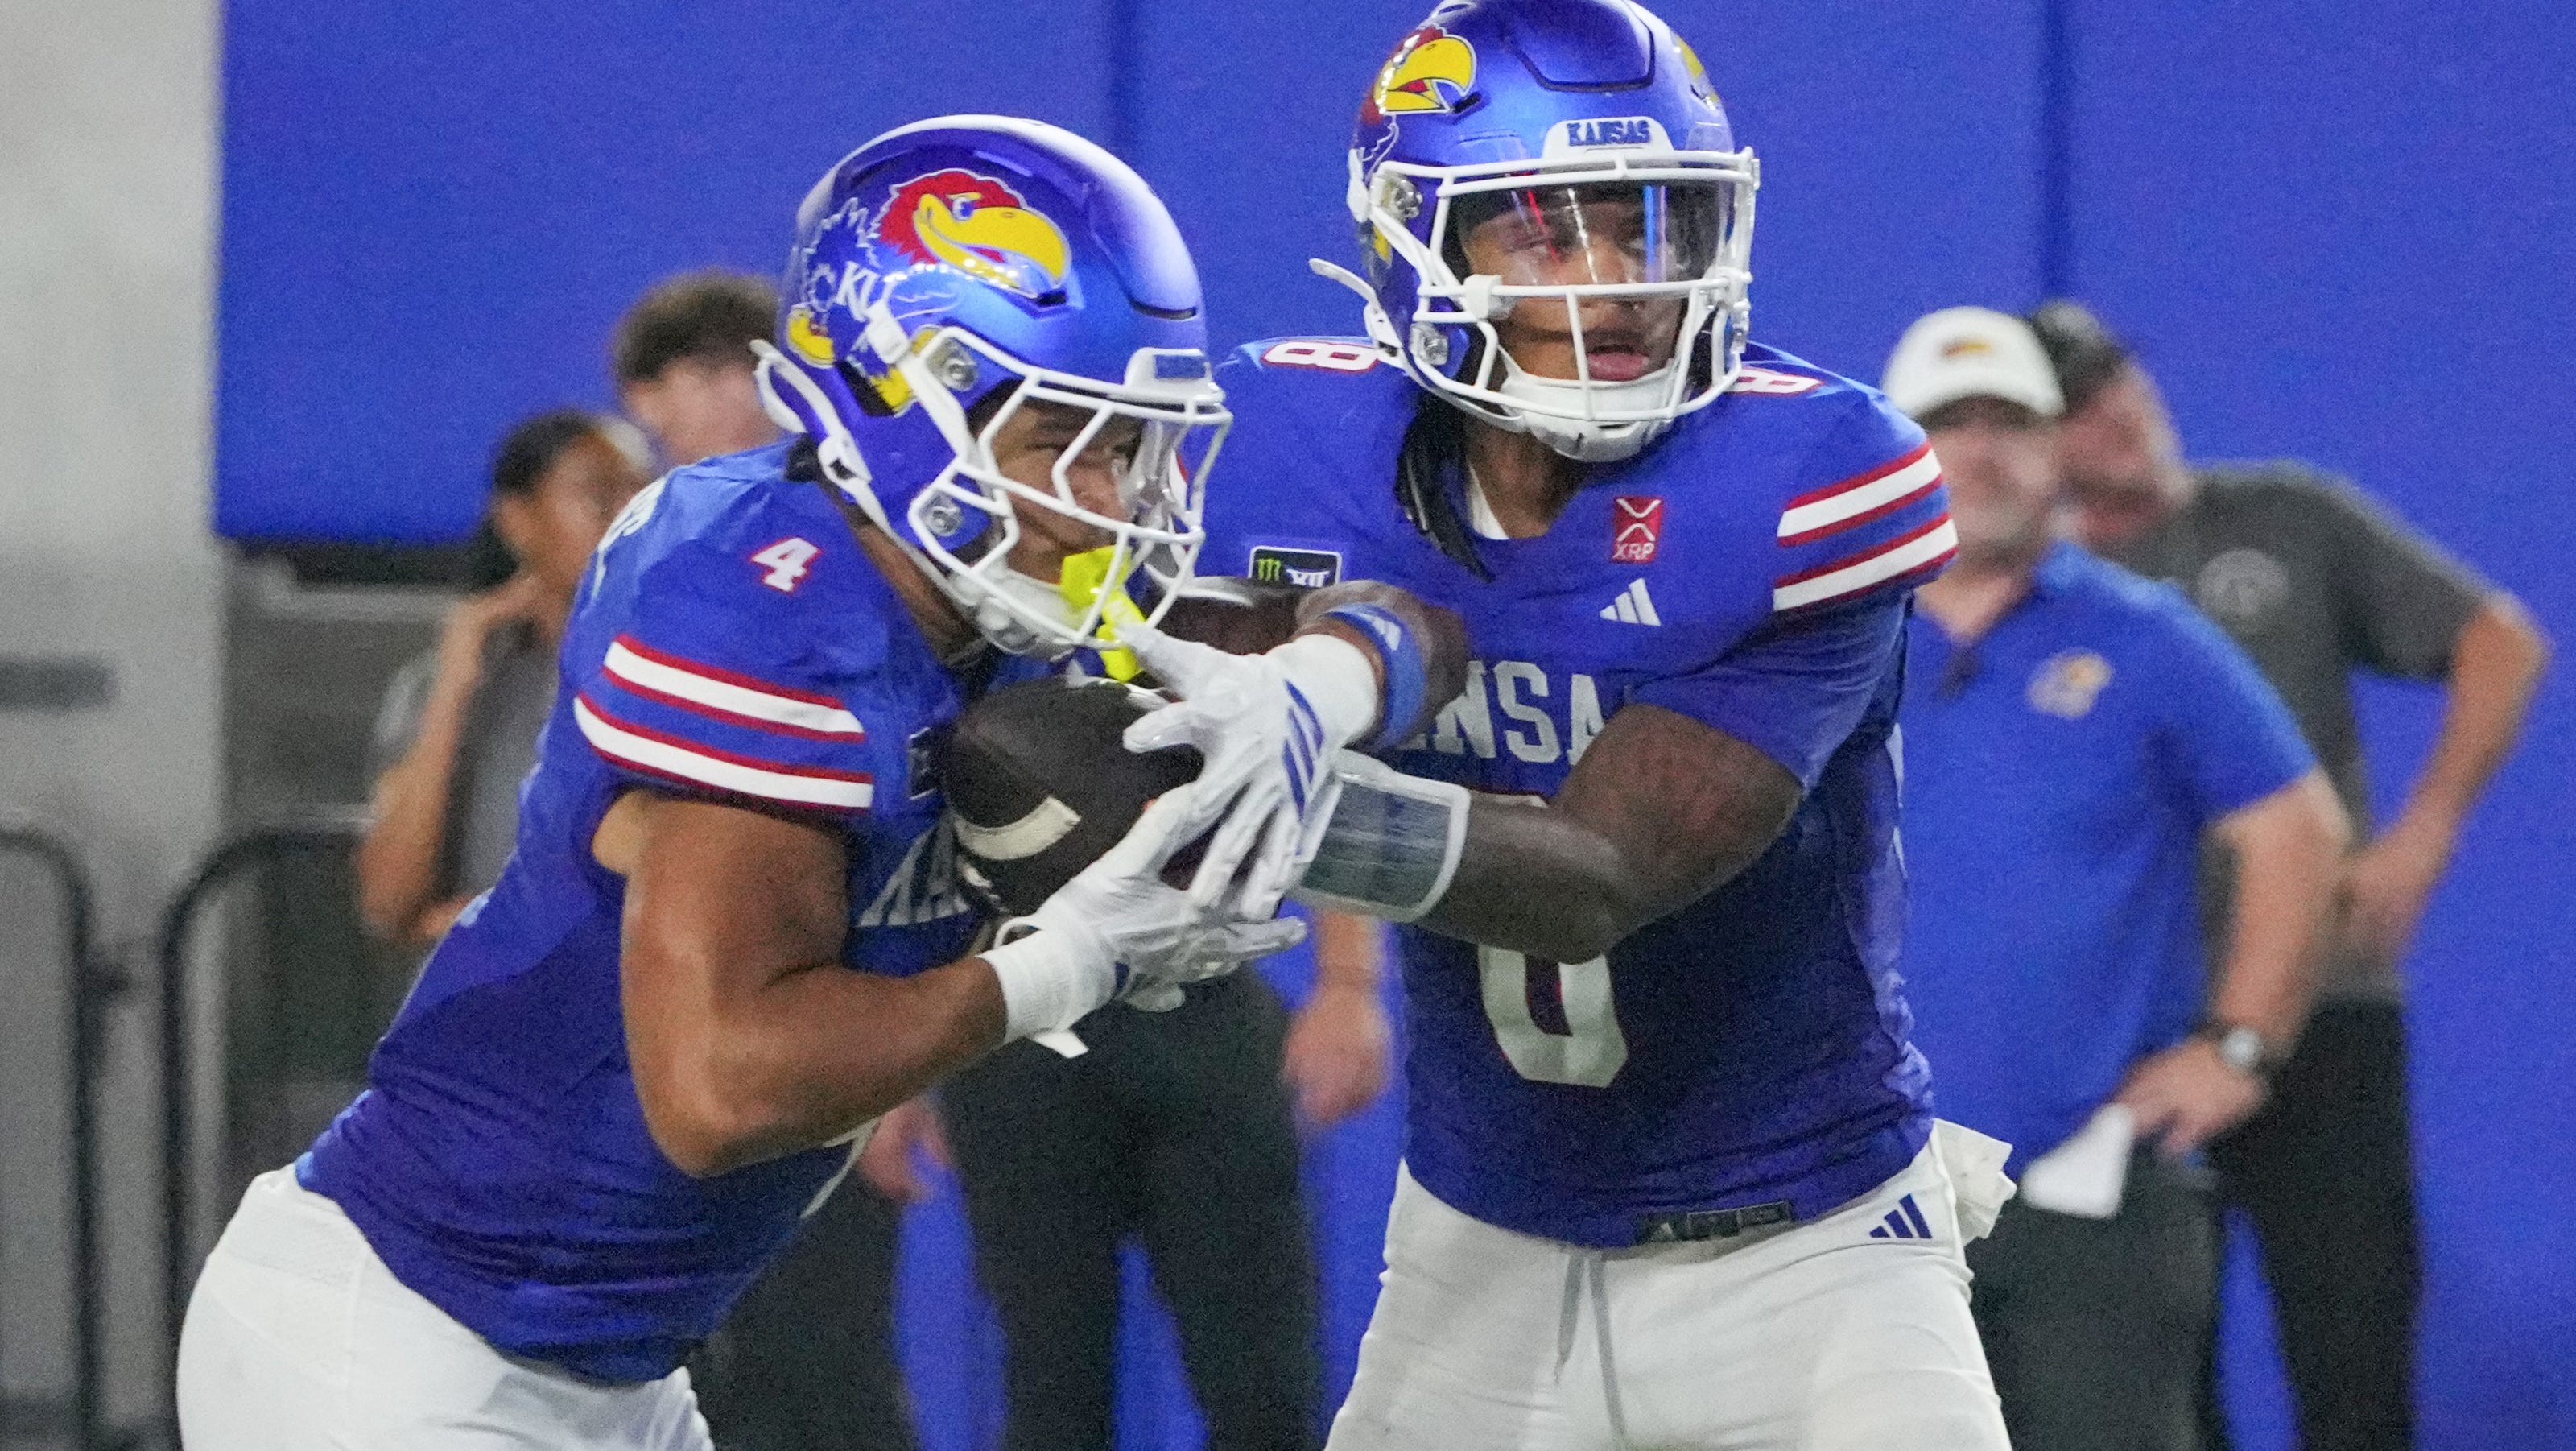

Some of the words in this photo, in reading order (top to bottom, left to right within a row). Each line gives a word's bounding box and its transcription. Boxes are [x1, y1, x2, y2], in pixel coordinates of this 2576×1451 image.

[1566, 119, 1651, 147] KANSAS
[1260, 341, 1380, 374] 8
[749, 535, 824, 596] 4
[1612, 542, 1655, 560] XRP
